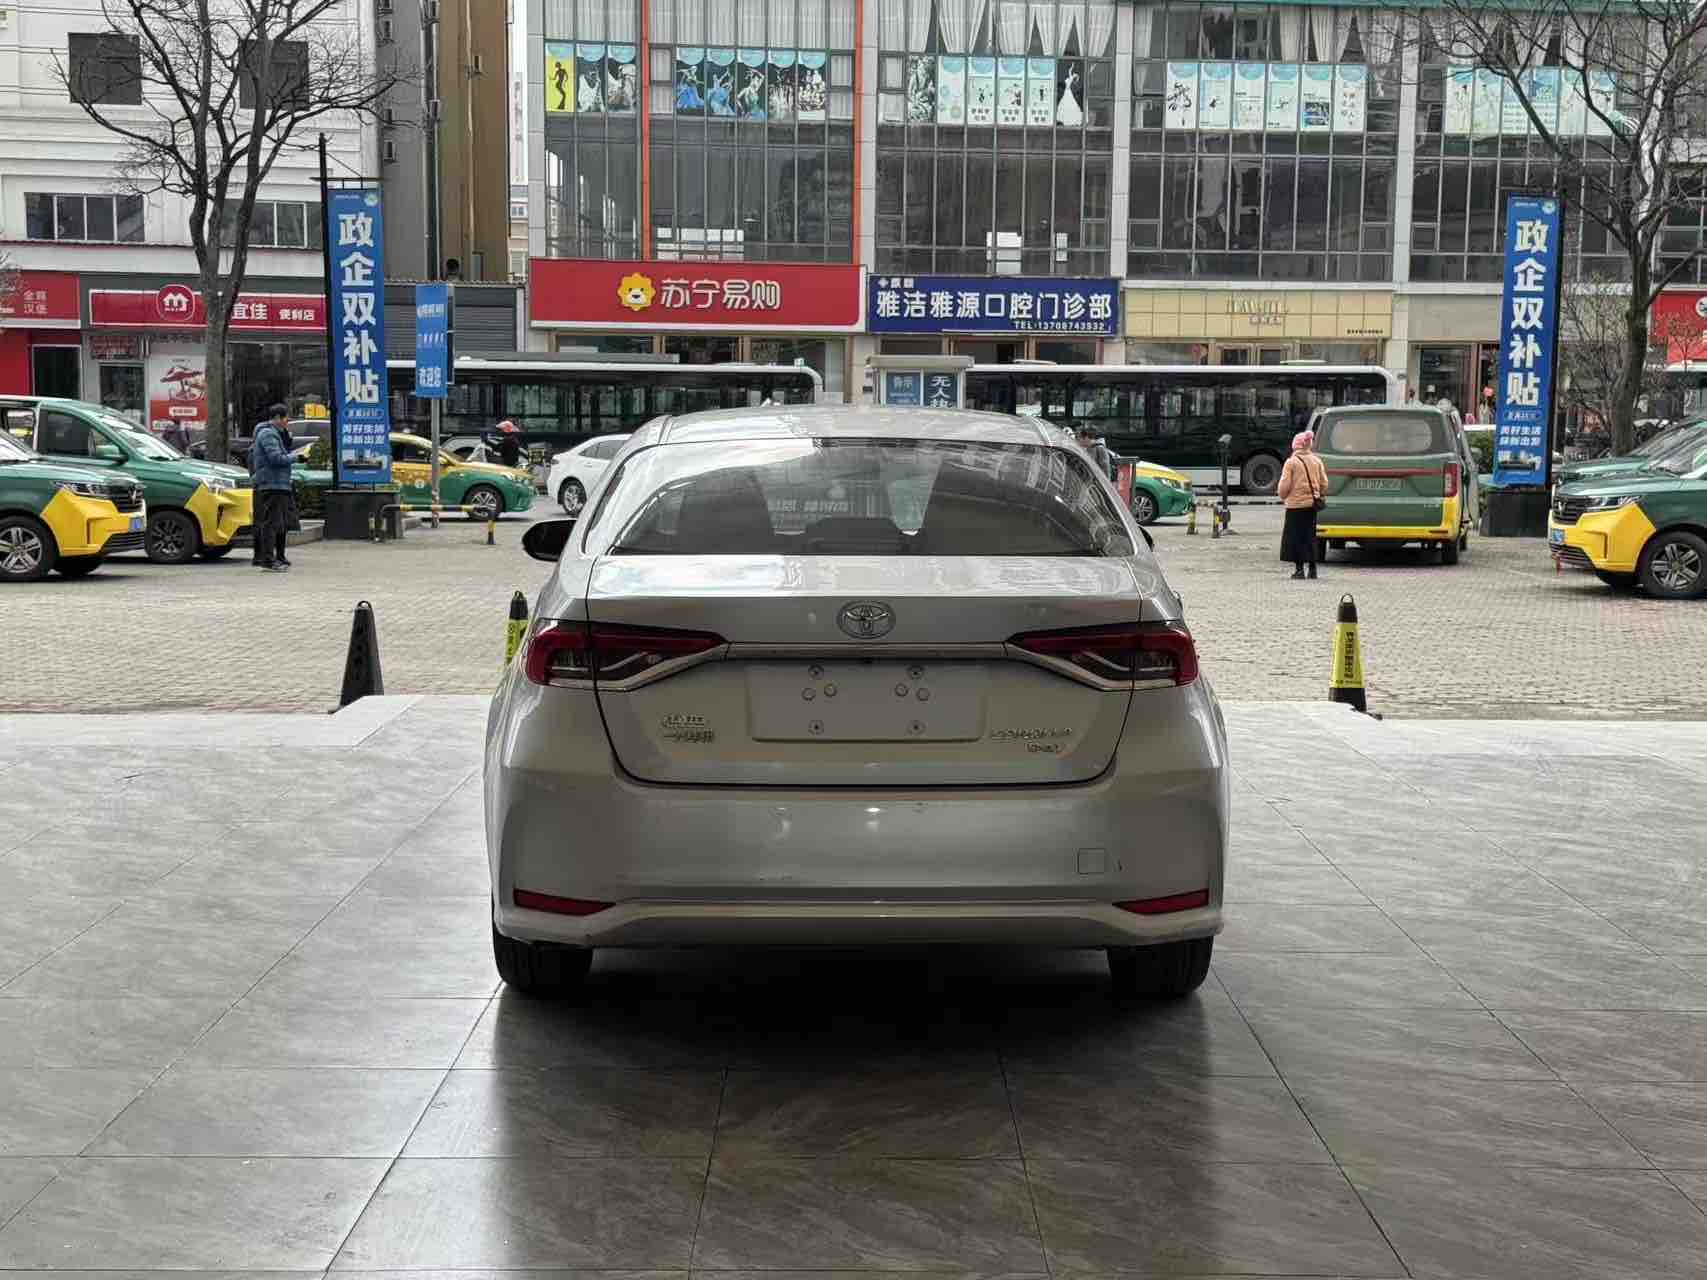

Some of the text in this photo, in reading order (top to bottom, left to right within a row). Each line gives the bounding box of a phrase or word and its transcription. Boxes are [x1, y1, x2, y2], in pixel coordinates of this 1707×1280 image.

[338, 212, 380, 405] 政企双补贴
[661, 278, 781, 310] 苏宁易购
[876, 291, 1112, 320] 雅洁雅源口腔门诊部
[231, 302, 268, 320] 宜佳
[1505, 219, 1549, 406] 政企双补贴
